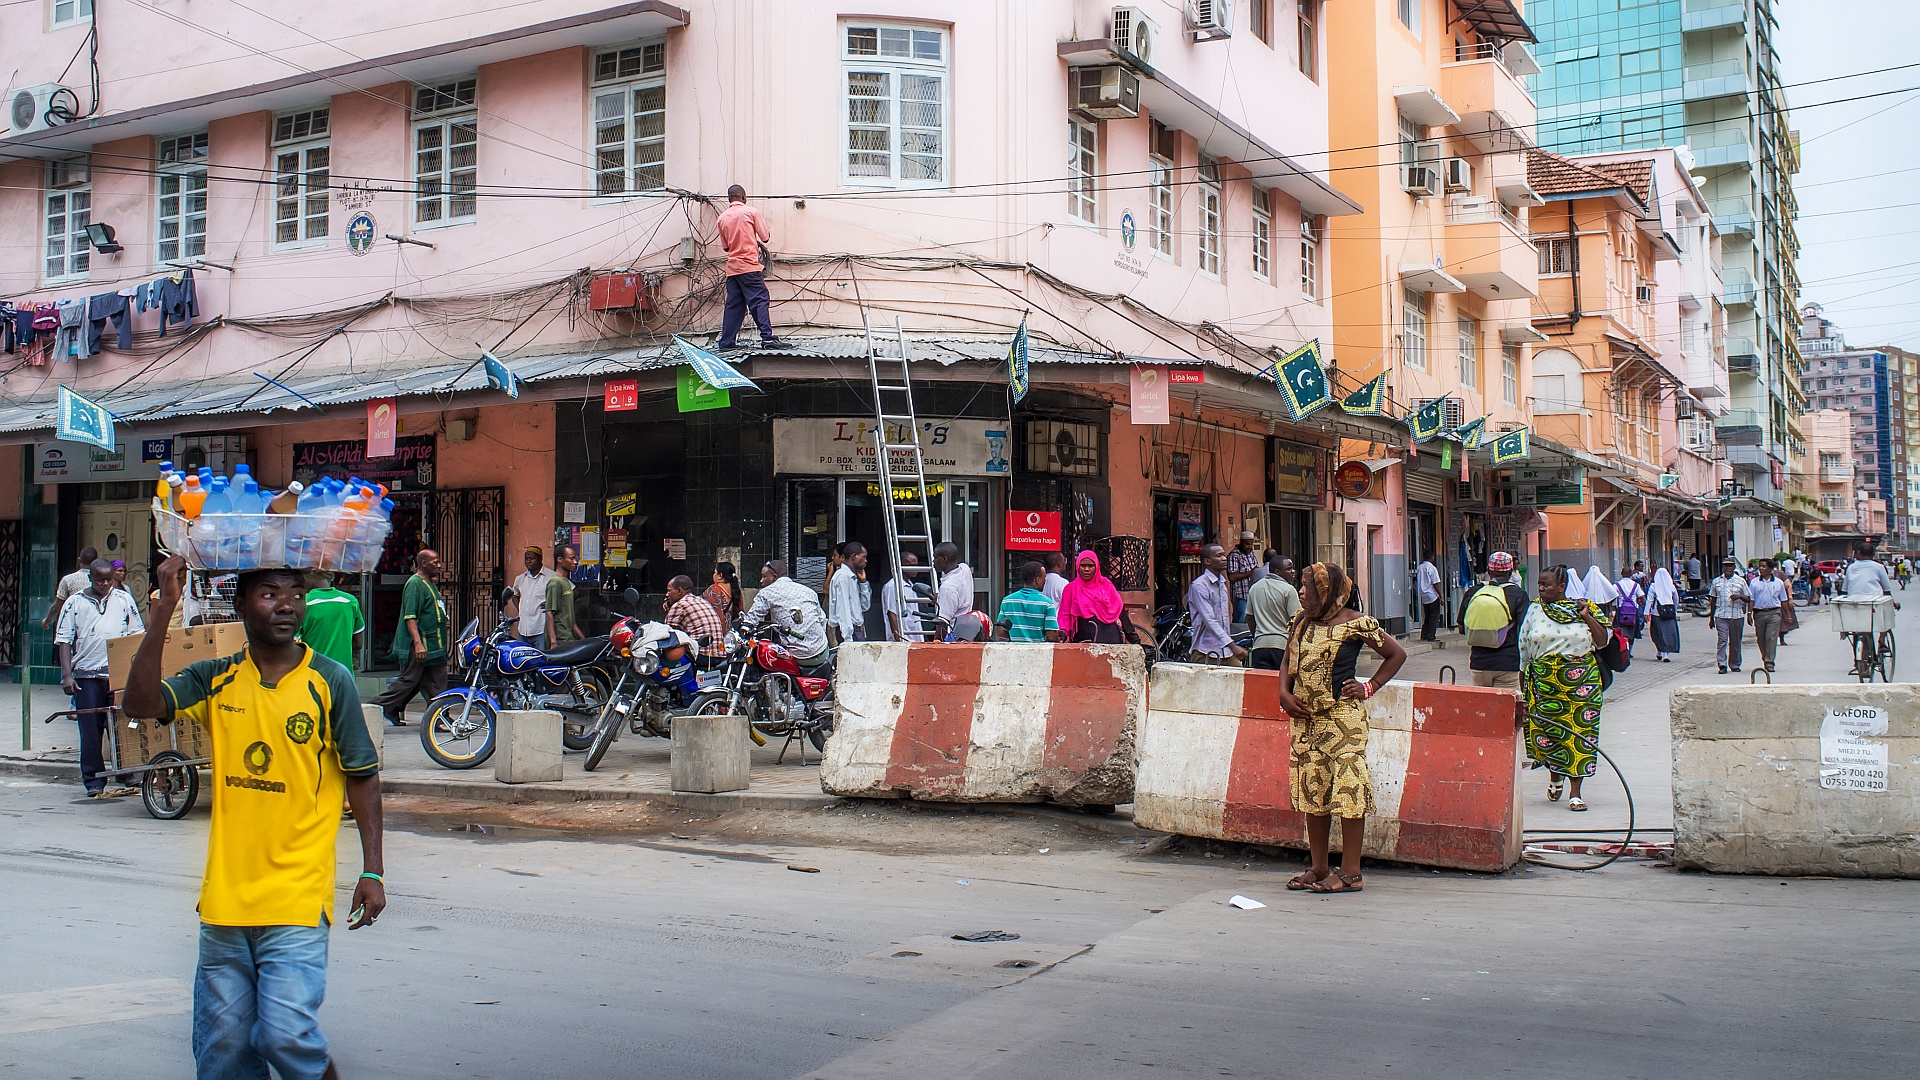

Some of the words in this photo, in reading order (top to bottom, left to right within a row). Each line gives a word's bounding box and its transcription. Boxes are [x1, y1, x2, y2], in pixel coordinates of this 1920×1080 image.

[1171, 373, 1185, 382] Lipa
[610, 384, 622, 392] Lipa
[623, 383, 635, 391] kwa
[1140, 391, 1158, 400] airtel
[373, 430, 389, 439] airtel
[148, 441, 165, 453] tigo
[891, 447, 924, 457] WORD
[296, 446, 315, 466] Al
[316, 443, 362, 465] Mehdi
[836, 456, 853, 464] BOX
[888, 457, 905, 465] DAR
[924, 457, 956, 466] SALAAM
[1344, 469, 1363, 477] Spice
[1849, 769, 1865, 777] 700
[1867, 770, 1884, 779] 420
[225, 774, 286, 793] vodacom
[1825, 777, 1847, 787] 0755
[1849, 779, 1865, 788] 700
[1867, 781, 1884, 789] 420
